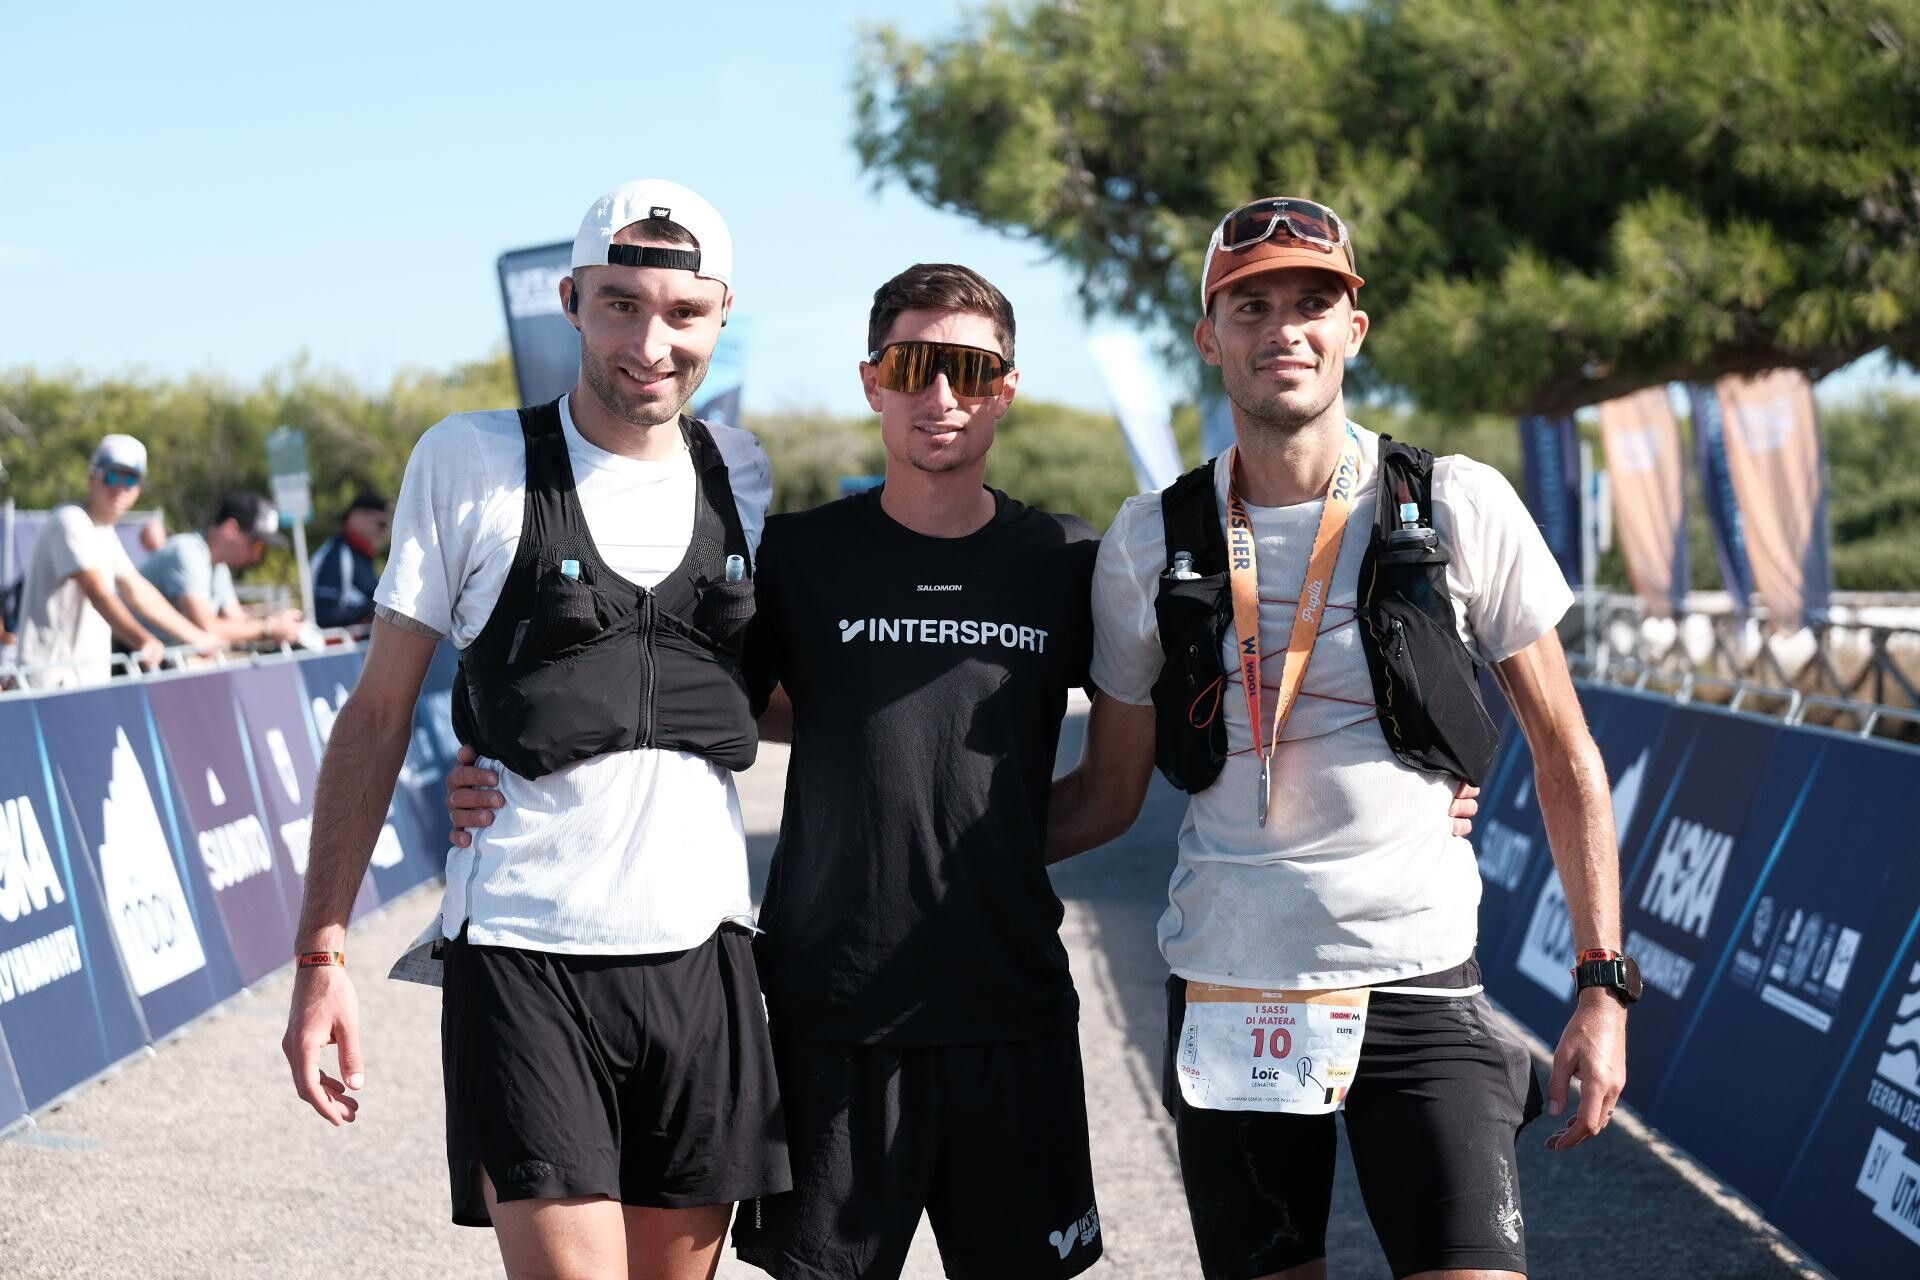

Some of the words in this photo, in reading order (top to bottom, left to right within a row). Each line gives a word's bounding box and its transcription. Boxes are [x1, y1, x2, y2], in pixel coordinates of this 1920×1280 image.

[1332, 455, 1356, 502] 2026
[916, 584, 962, 592] SALOMON
[1302, 579, 1322, 624] Puglia
[869, 617, 1049, 654] INTERSPORT
[1638, 815, 1735, 940] HOKA
[1245, 1017, 1256, 1025] DI
[1258, 1017, 1296, 1026] MATERA
[1255, 1006, 1259, 1014] I
[1261, 1005, 1288, 1014] SASSI
[1250, 1027, 1292, 1060] 10
[1336, 1027, 1353, 1035] ELITE
[1251, 1066, 1280, 1080] Loïc
[1867, 1079, 1904, 1118] TERRA
[1867, 1144, 1893, 1184] BY
[1891, 1171, 1920, 1228] UTM
